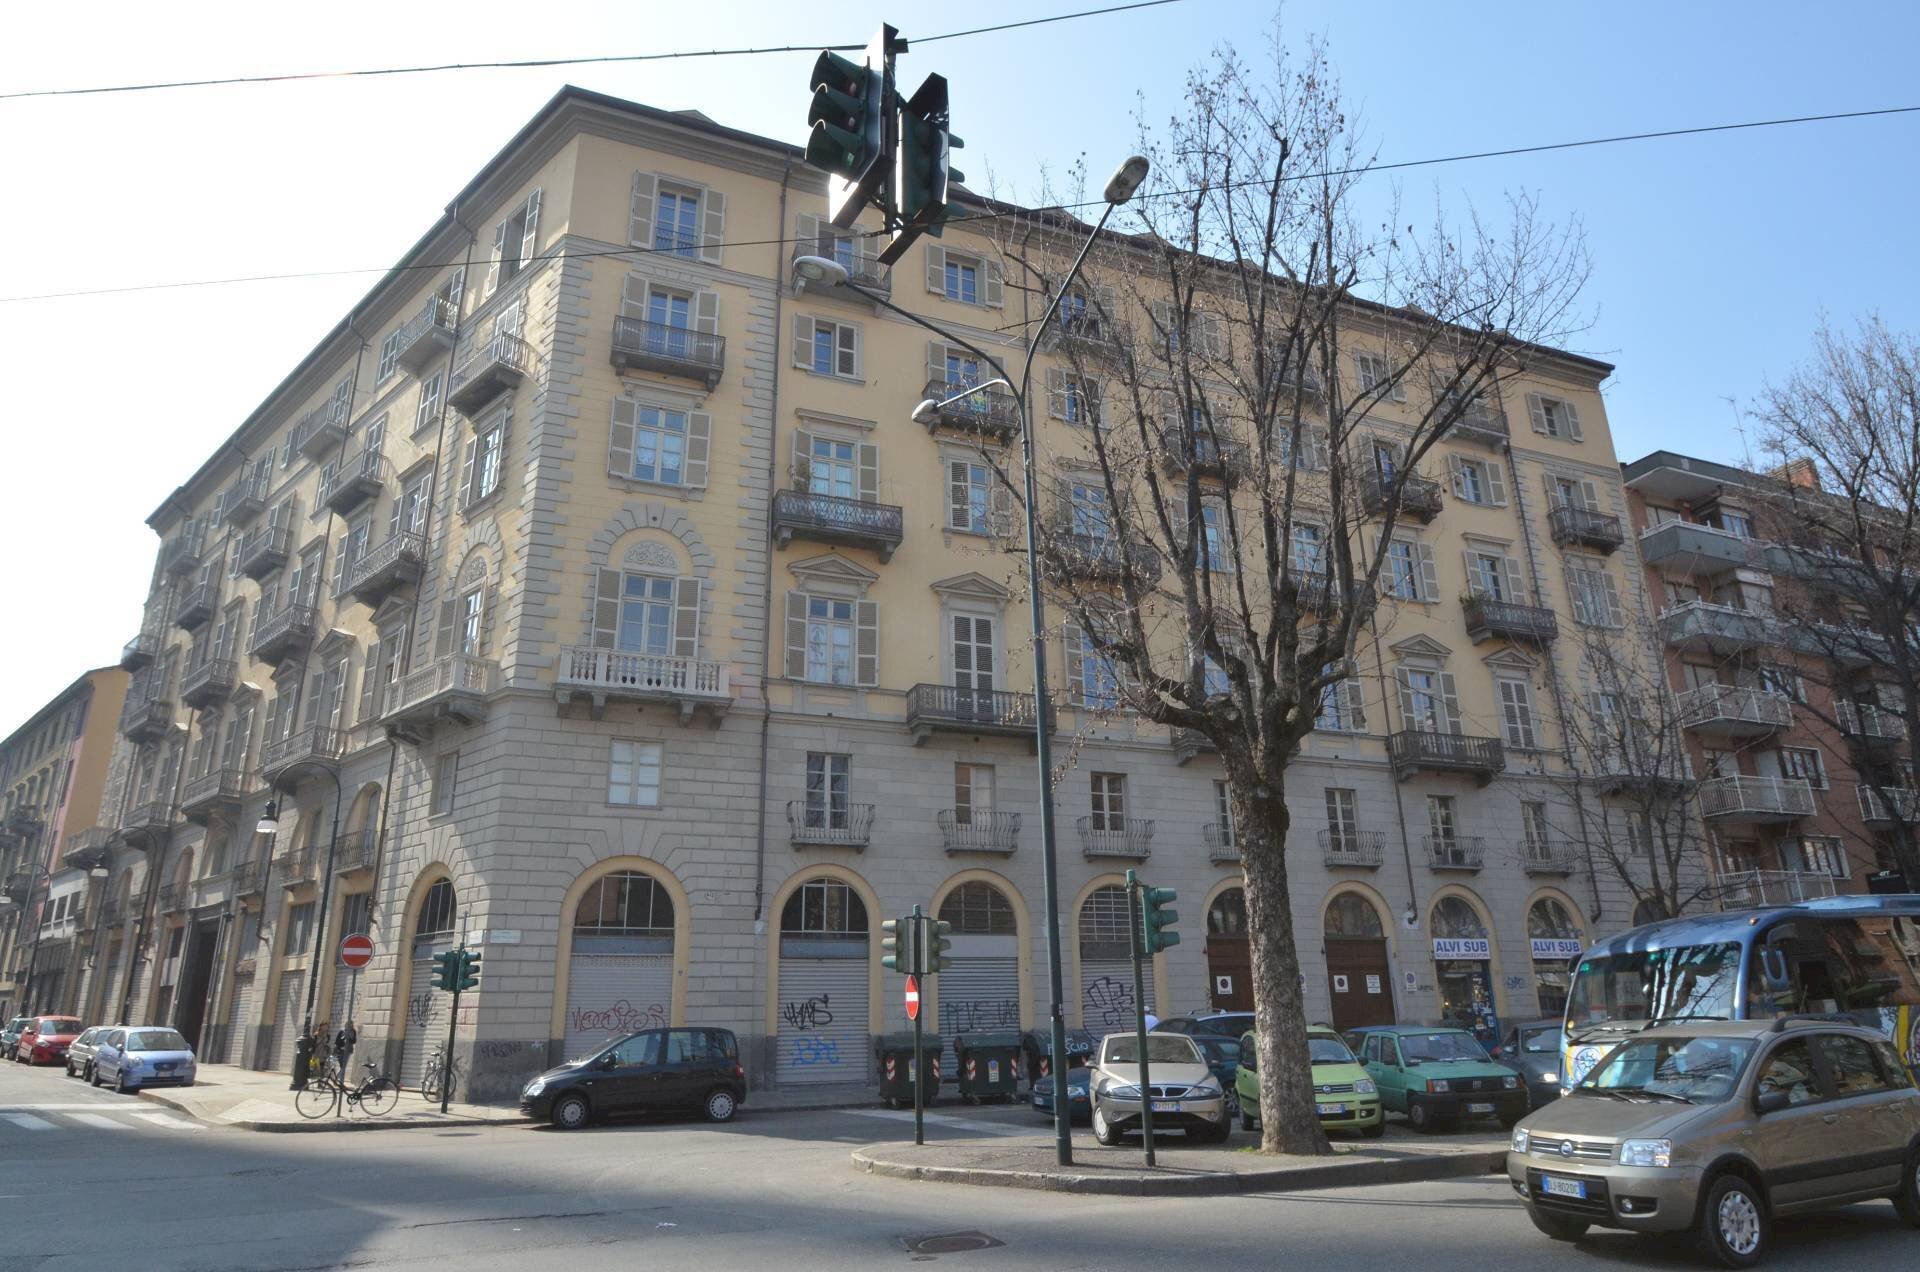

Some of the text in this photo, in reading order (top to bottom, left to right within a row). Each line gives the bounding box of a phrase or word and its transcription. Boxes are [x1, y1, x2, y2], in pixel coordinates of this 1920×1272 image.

[1436, 941, 1488, 952] ALVI SUB
[1533, 941, 1580, 952] ALVI SUB
